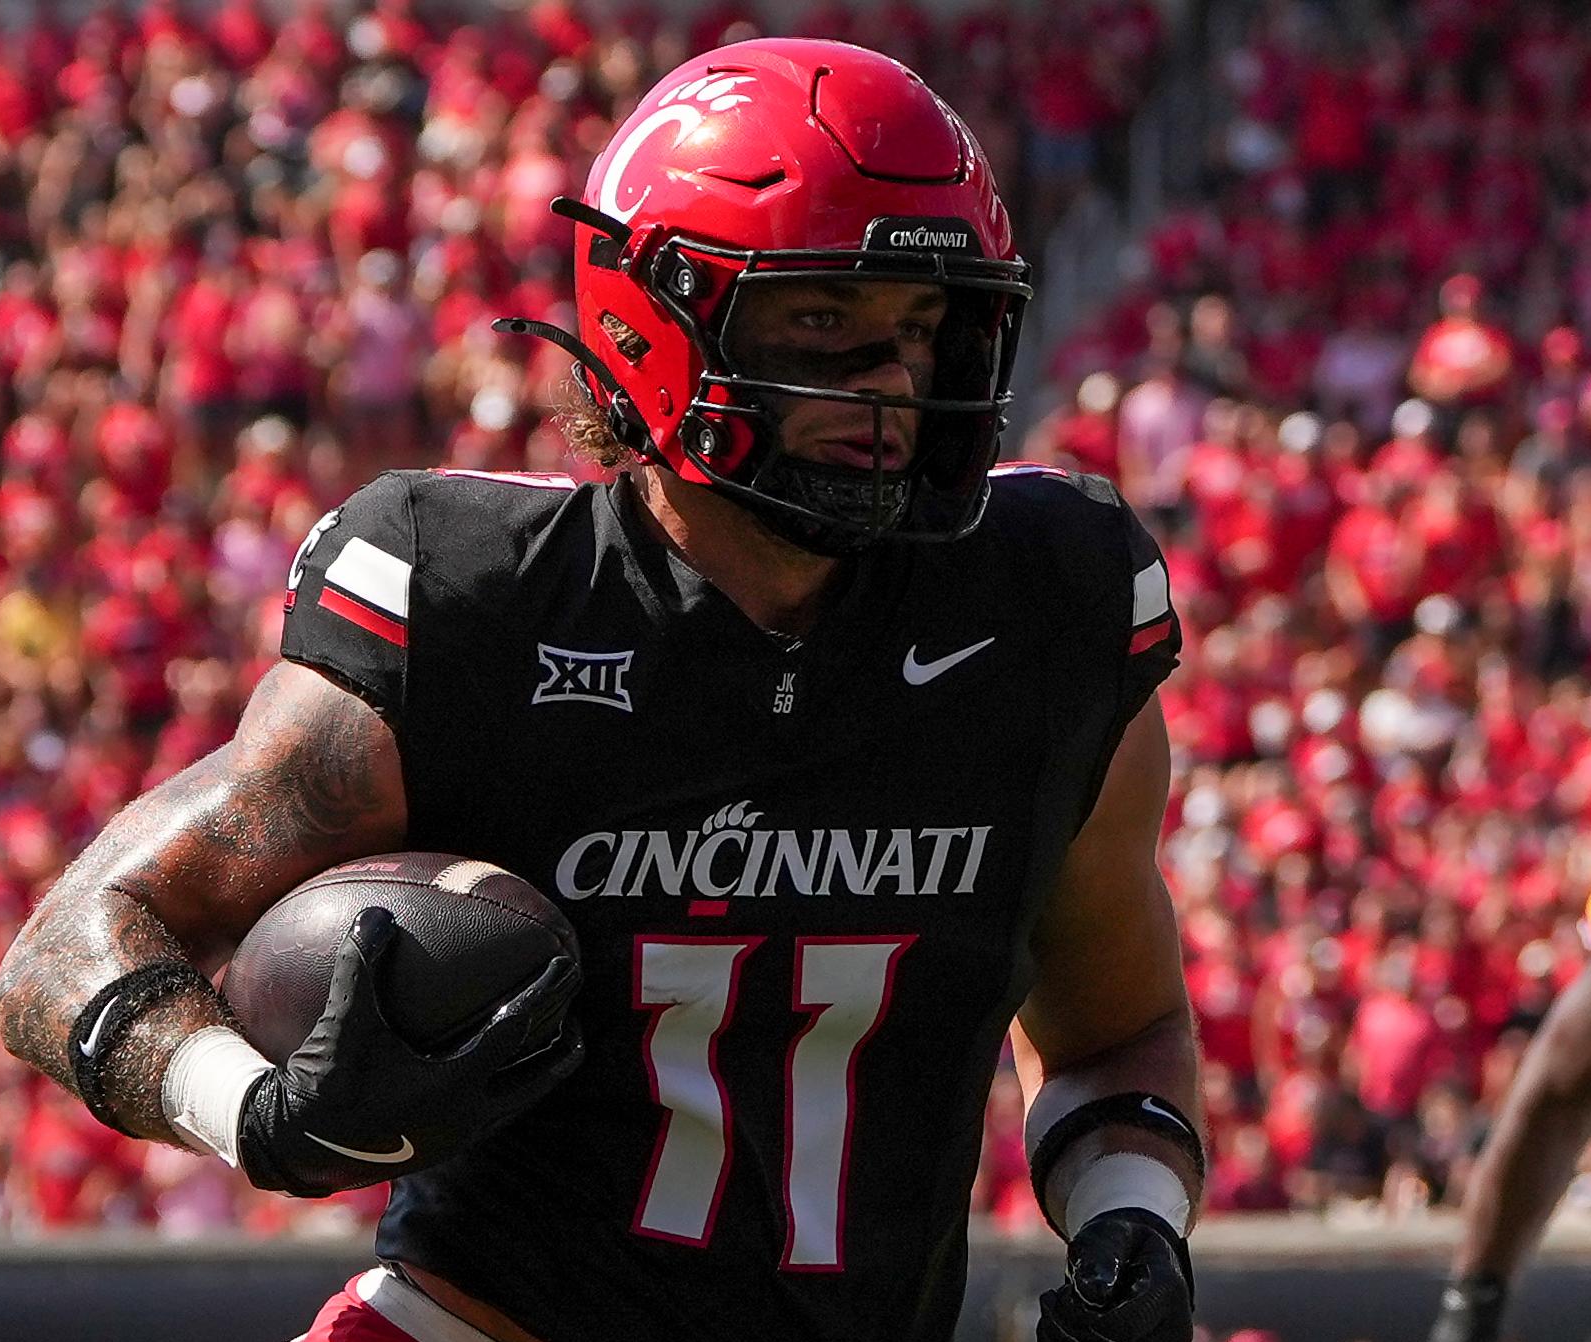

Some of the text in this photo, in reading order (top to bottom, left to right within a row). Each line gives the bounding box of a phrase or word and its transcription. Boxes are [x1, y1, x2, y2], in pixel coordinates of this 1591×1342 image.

[890, 227, 967, 248] CINCINNATI
[776, 672, 796, 693] JK
[773, 694, 794, 713] 58
[555, 801, 993, 900] CINCINNATI
[630, 934, 921, 1274] 11
